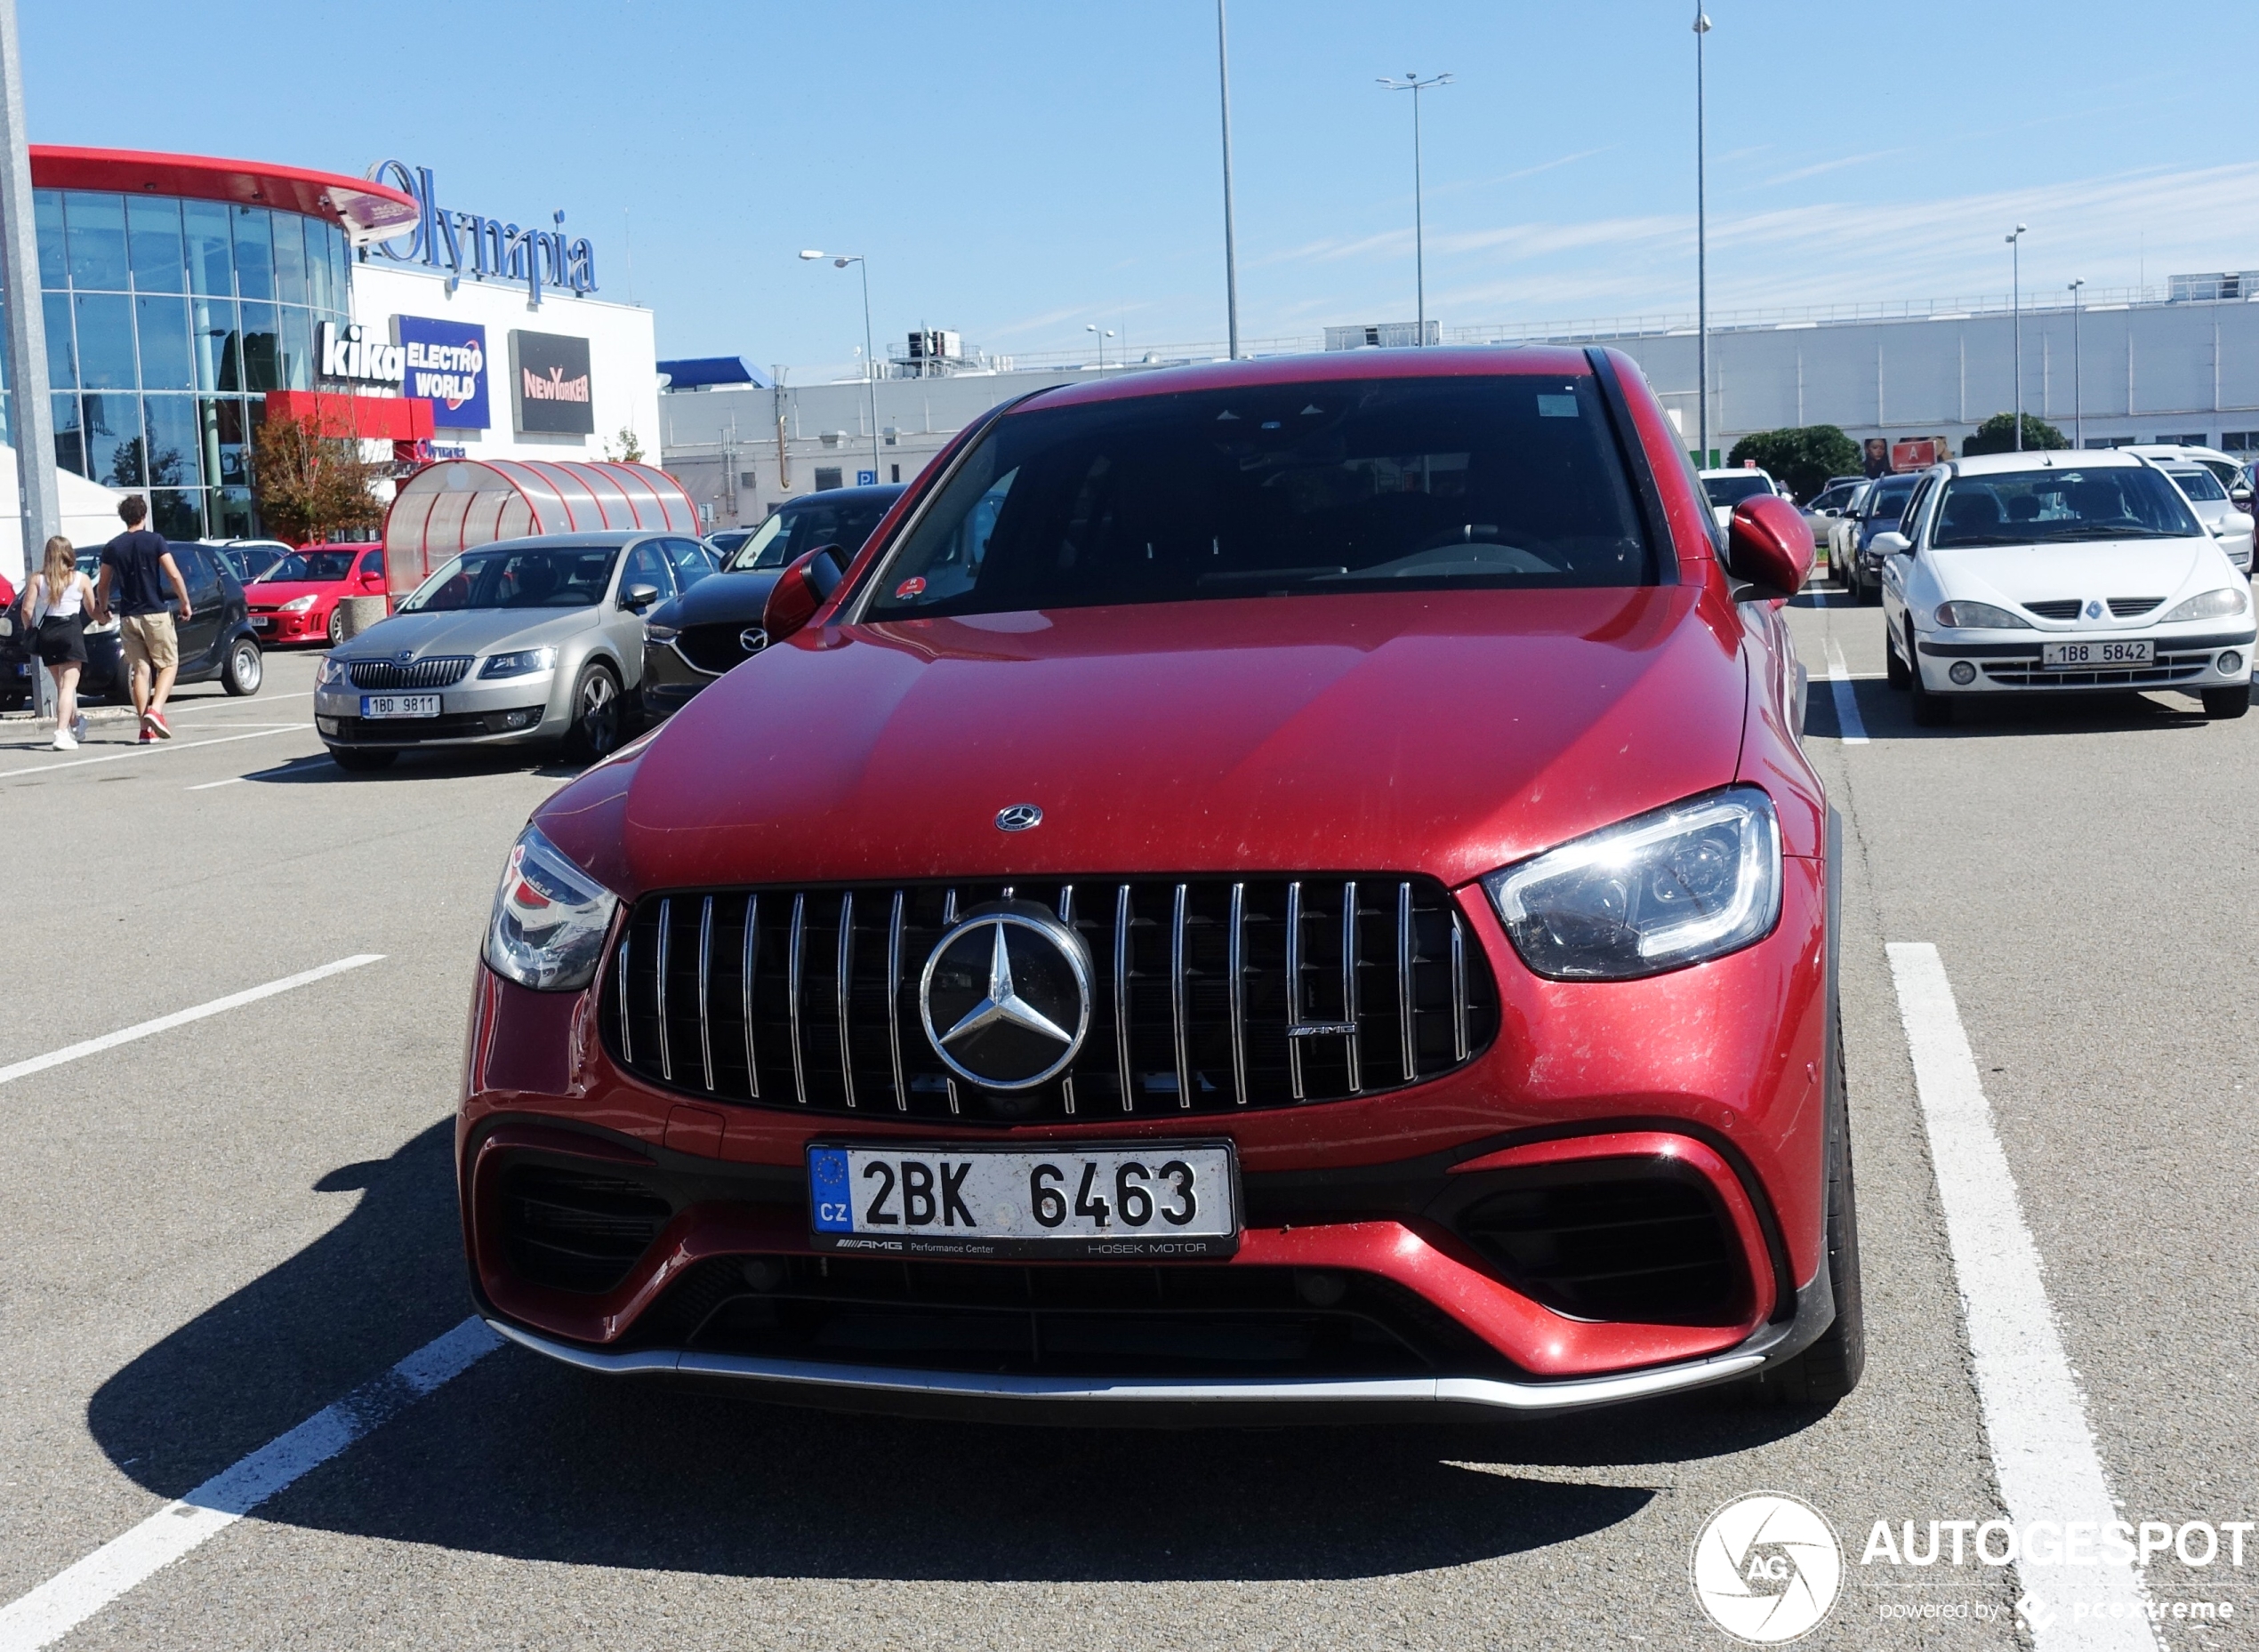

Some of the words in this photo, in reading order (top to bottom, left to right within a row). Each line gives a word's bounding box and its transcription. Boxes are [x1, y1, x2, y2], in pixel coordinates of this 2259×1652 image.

[366, 159, 599, 304] Olympia
[322, 322, 406, 381] kika
[407, 341, 483, 373] ELECTRO
[415, 372, 476, 400] WORLD
[1909, 445, 1918, 461] A
[2058, 646, 2089, 662] 1B8
[2103, 644, 2146, 660] 5842
[403, 696, 433, 711] 9811
[863, 1160, 977, 1228] 2BK
[1030, 1159, 1197, 1228] 6463
[820, 1202, 848, 1222] CZ
[911, 1242, 963, 1253] Performance
[965, 1244, 994, 1254] Center
[1088, 1243, 1144, 1254] HOŠEK
[1149, 1243, 1207, 1253] MOTOR
